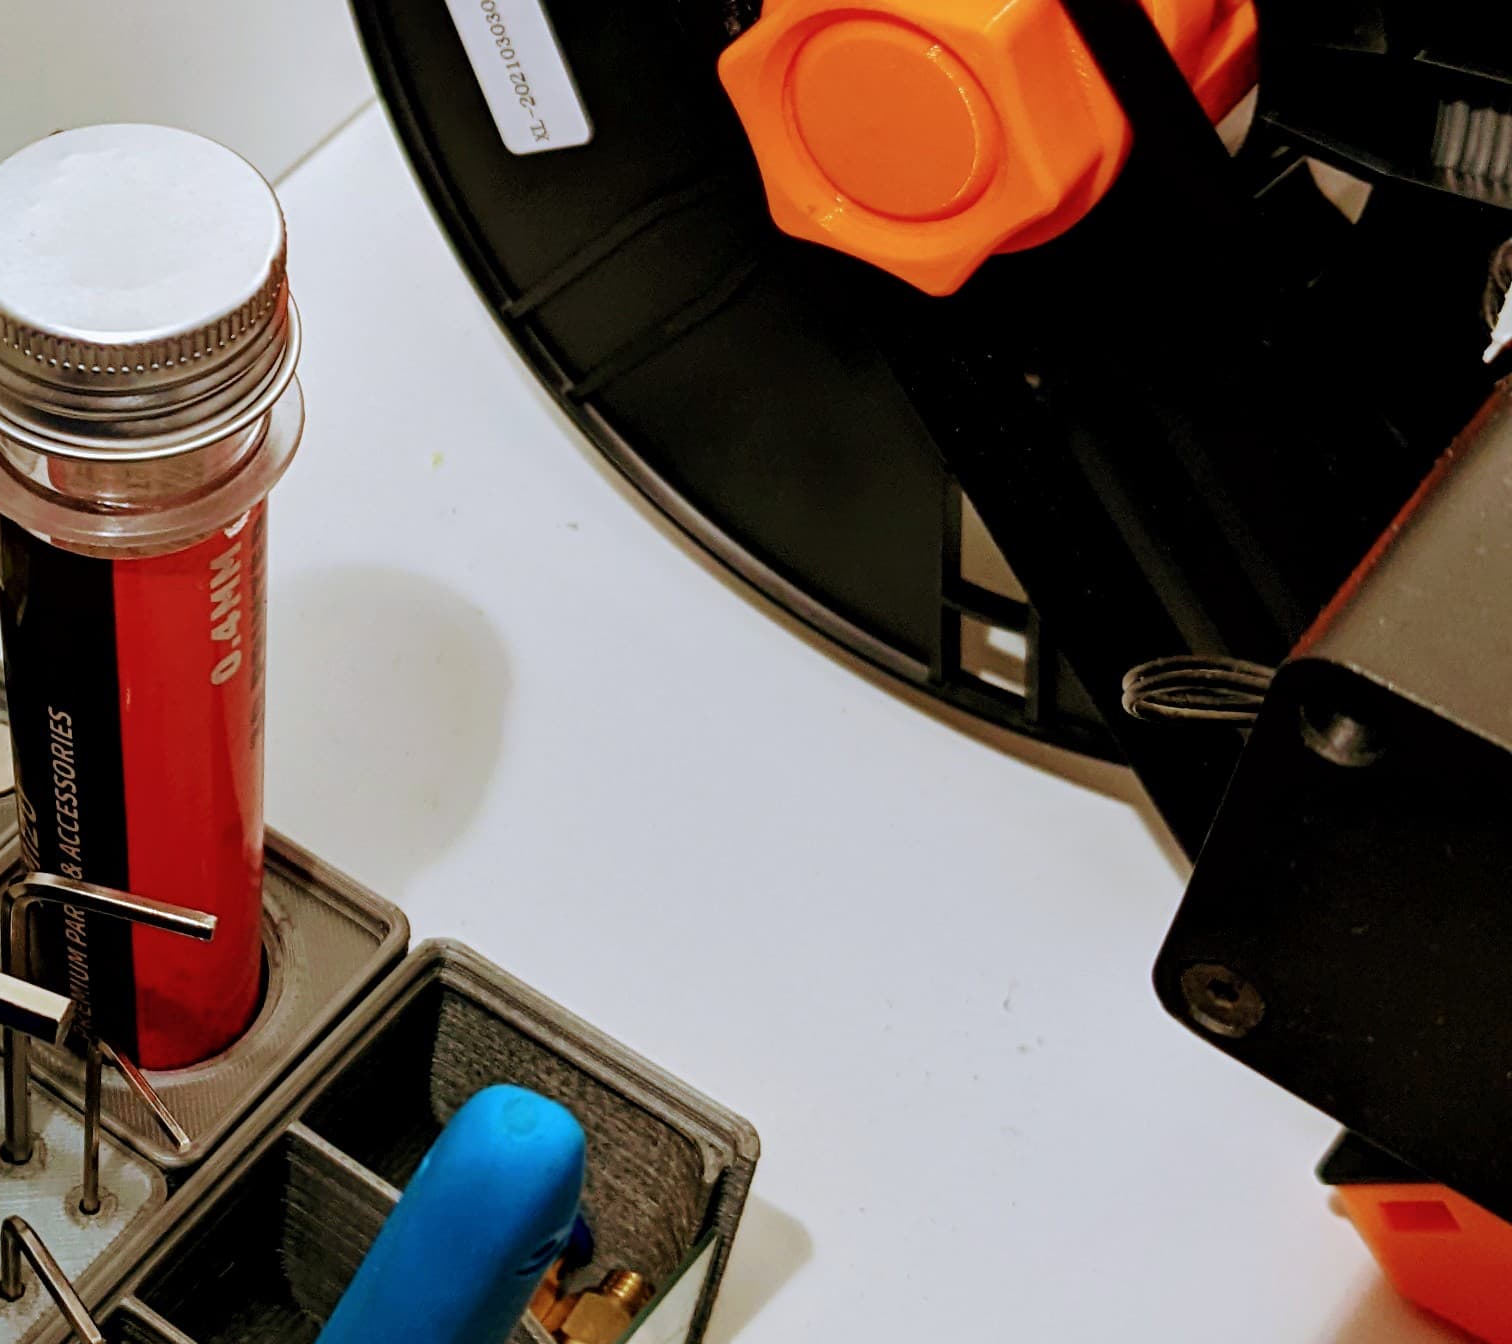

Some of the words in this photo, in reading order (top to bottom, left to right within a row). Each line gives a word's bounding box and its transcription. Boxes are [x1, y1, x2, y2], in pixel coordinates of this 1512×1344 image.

[209, 541, 243, 686] 0.4MM
[47, 705, 82, 860] ACCESSORIES
[63, 902, 88, 943] PAR
